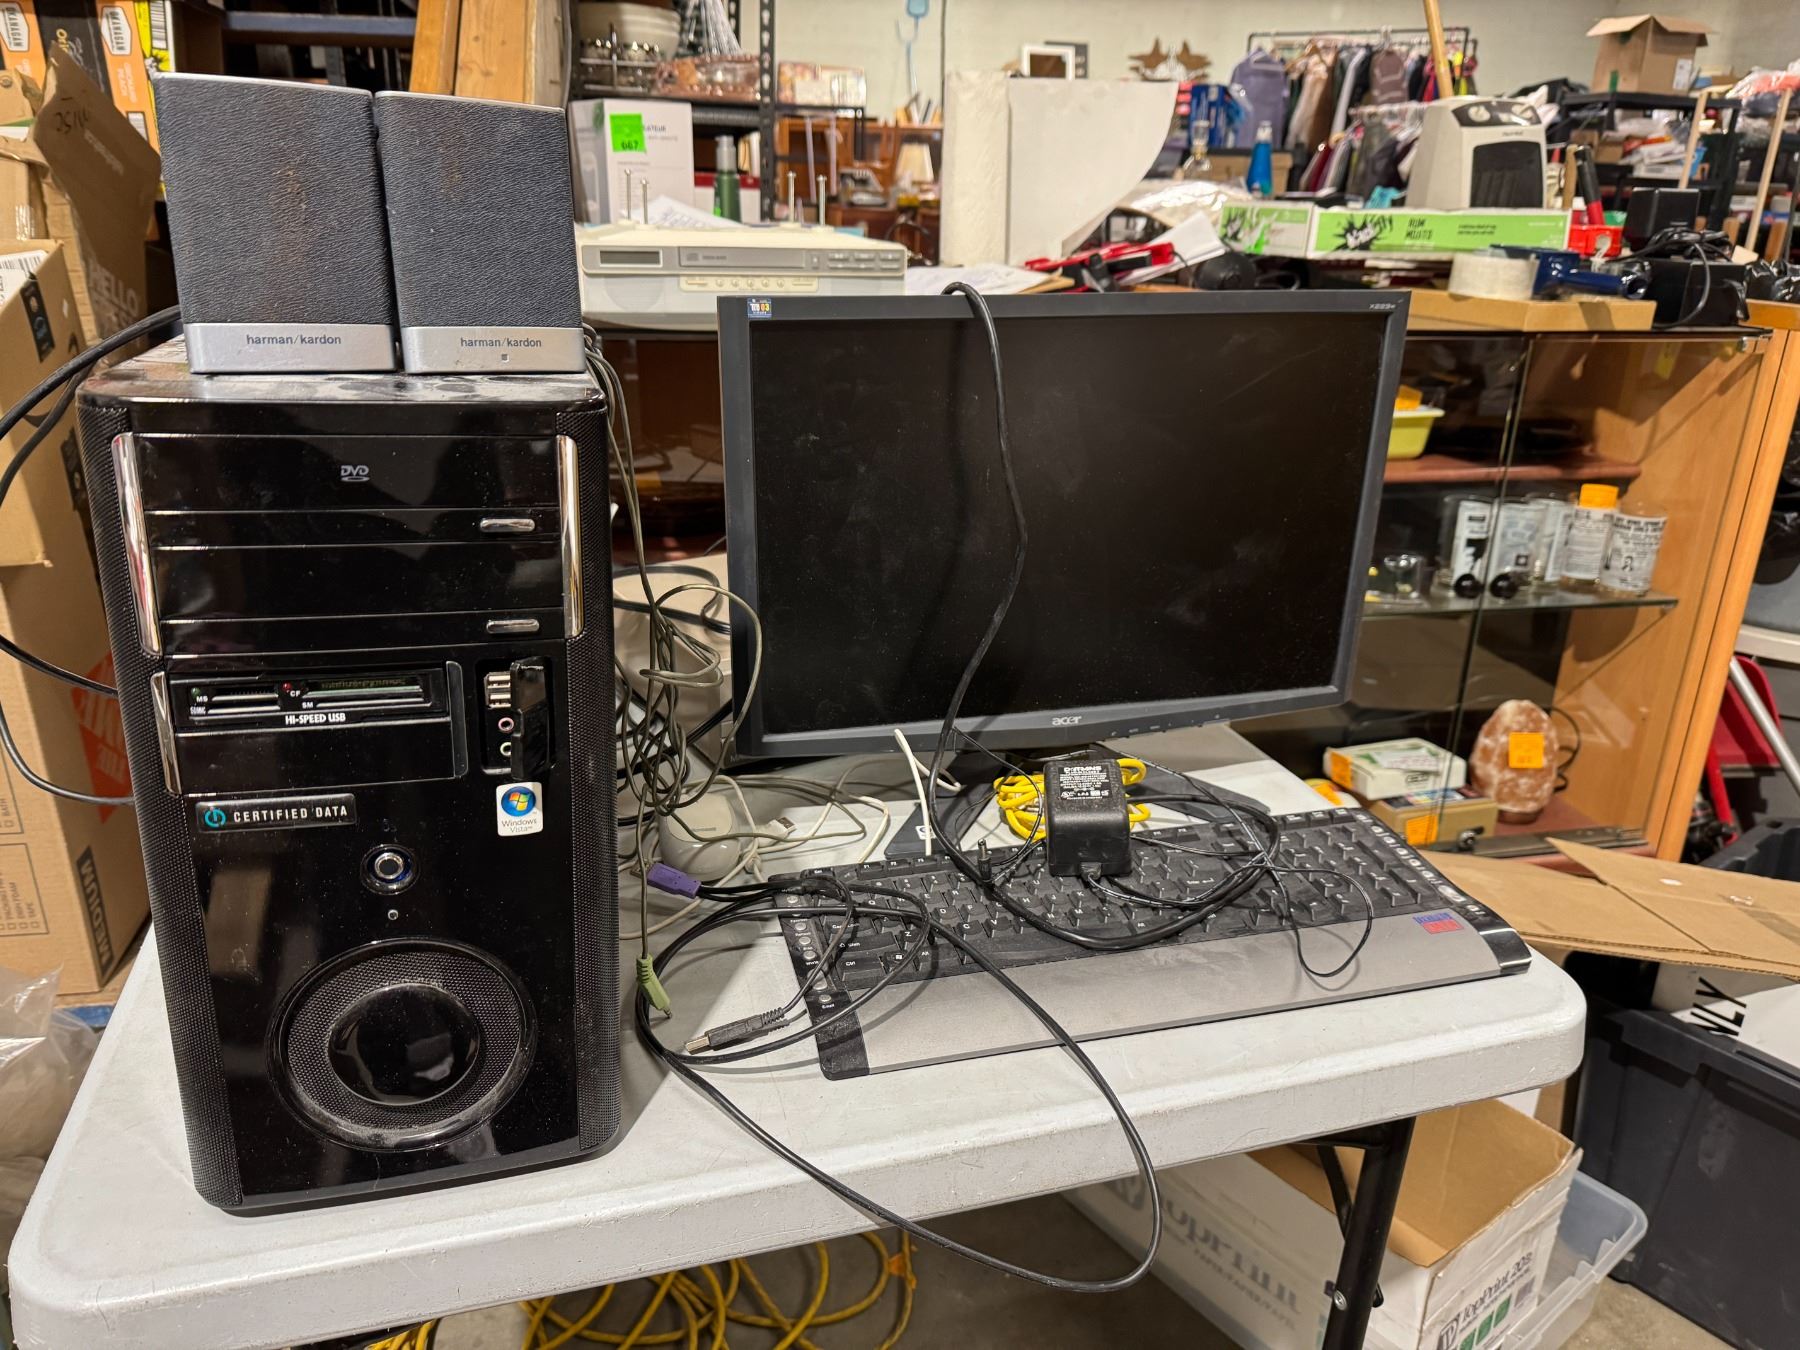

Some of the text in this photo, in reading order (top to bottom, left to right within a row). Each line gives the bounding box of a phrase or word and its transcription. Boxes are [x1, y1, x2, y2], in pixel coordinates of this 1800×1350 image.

[5, 7, 24, 47] OKANAGAN
[109, 11, 126, 51] OKANAGAN
[246, 334, 342, 346] harman/kardon
[460, 337, 542, 348] harman/kardon
[341, 465, 369, 478] DVD
[196, 695, 208, 703] MS
[290, 690, 300, 698] CF
[302, 701, 313, 709] SM
[285, 712, 346, 726] HI-SPEED USB
[1052, 715, 1082, 726] acer
[233, 805, 348, 823] CERTIFIED DATA
[501, 818, 537, 827] Windows
[81, 858, 112, 967] MEDIUM
